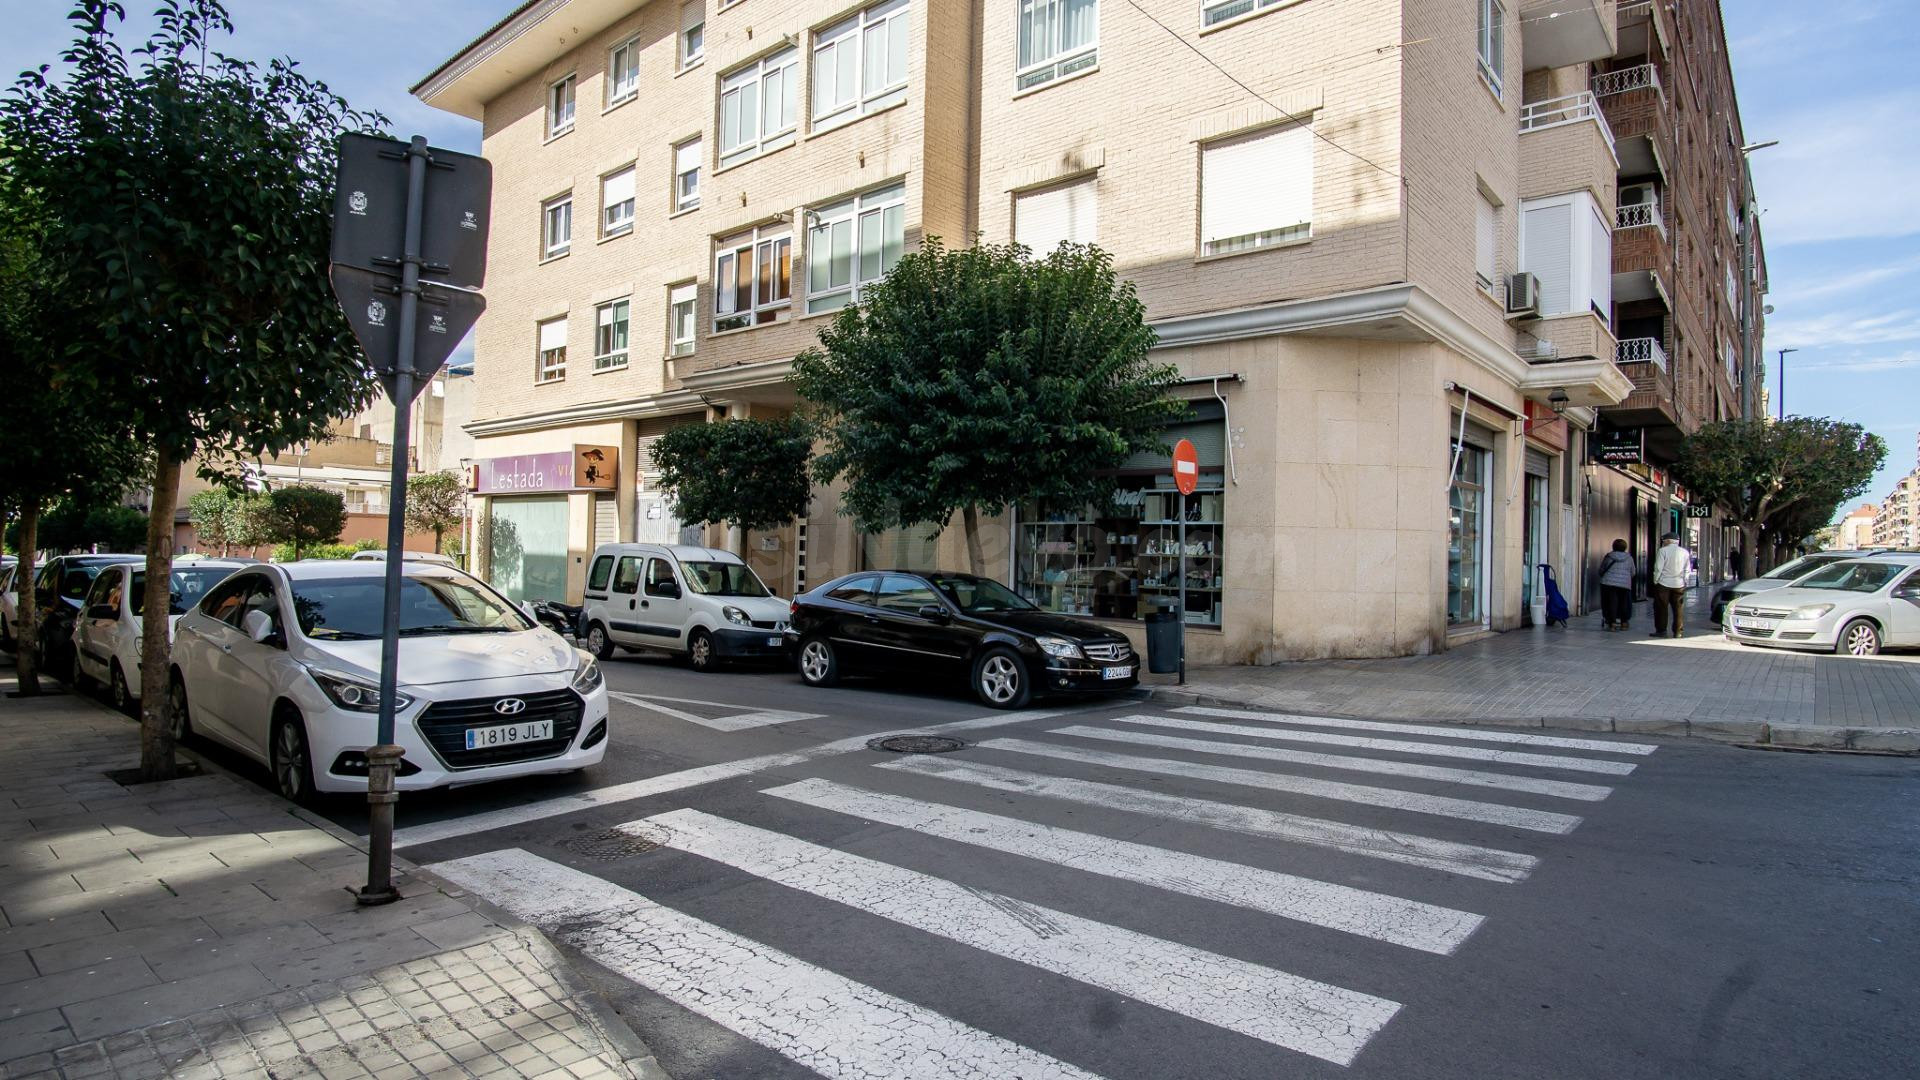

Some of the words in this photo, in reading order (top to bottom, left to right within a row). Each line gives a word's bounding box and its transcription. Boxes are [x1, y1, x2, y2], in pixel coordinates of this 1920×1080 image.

[491, 458, 543, 489] Lestada
[1107, 668, 1122, 678] 2244
[480, 727, 517, 745] 1819
[522, 723, 549, 740] JLY
